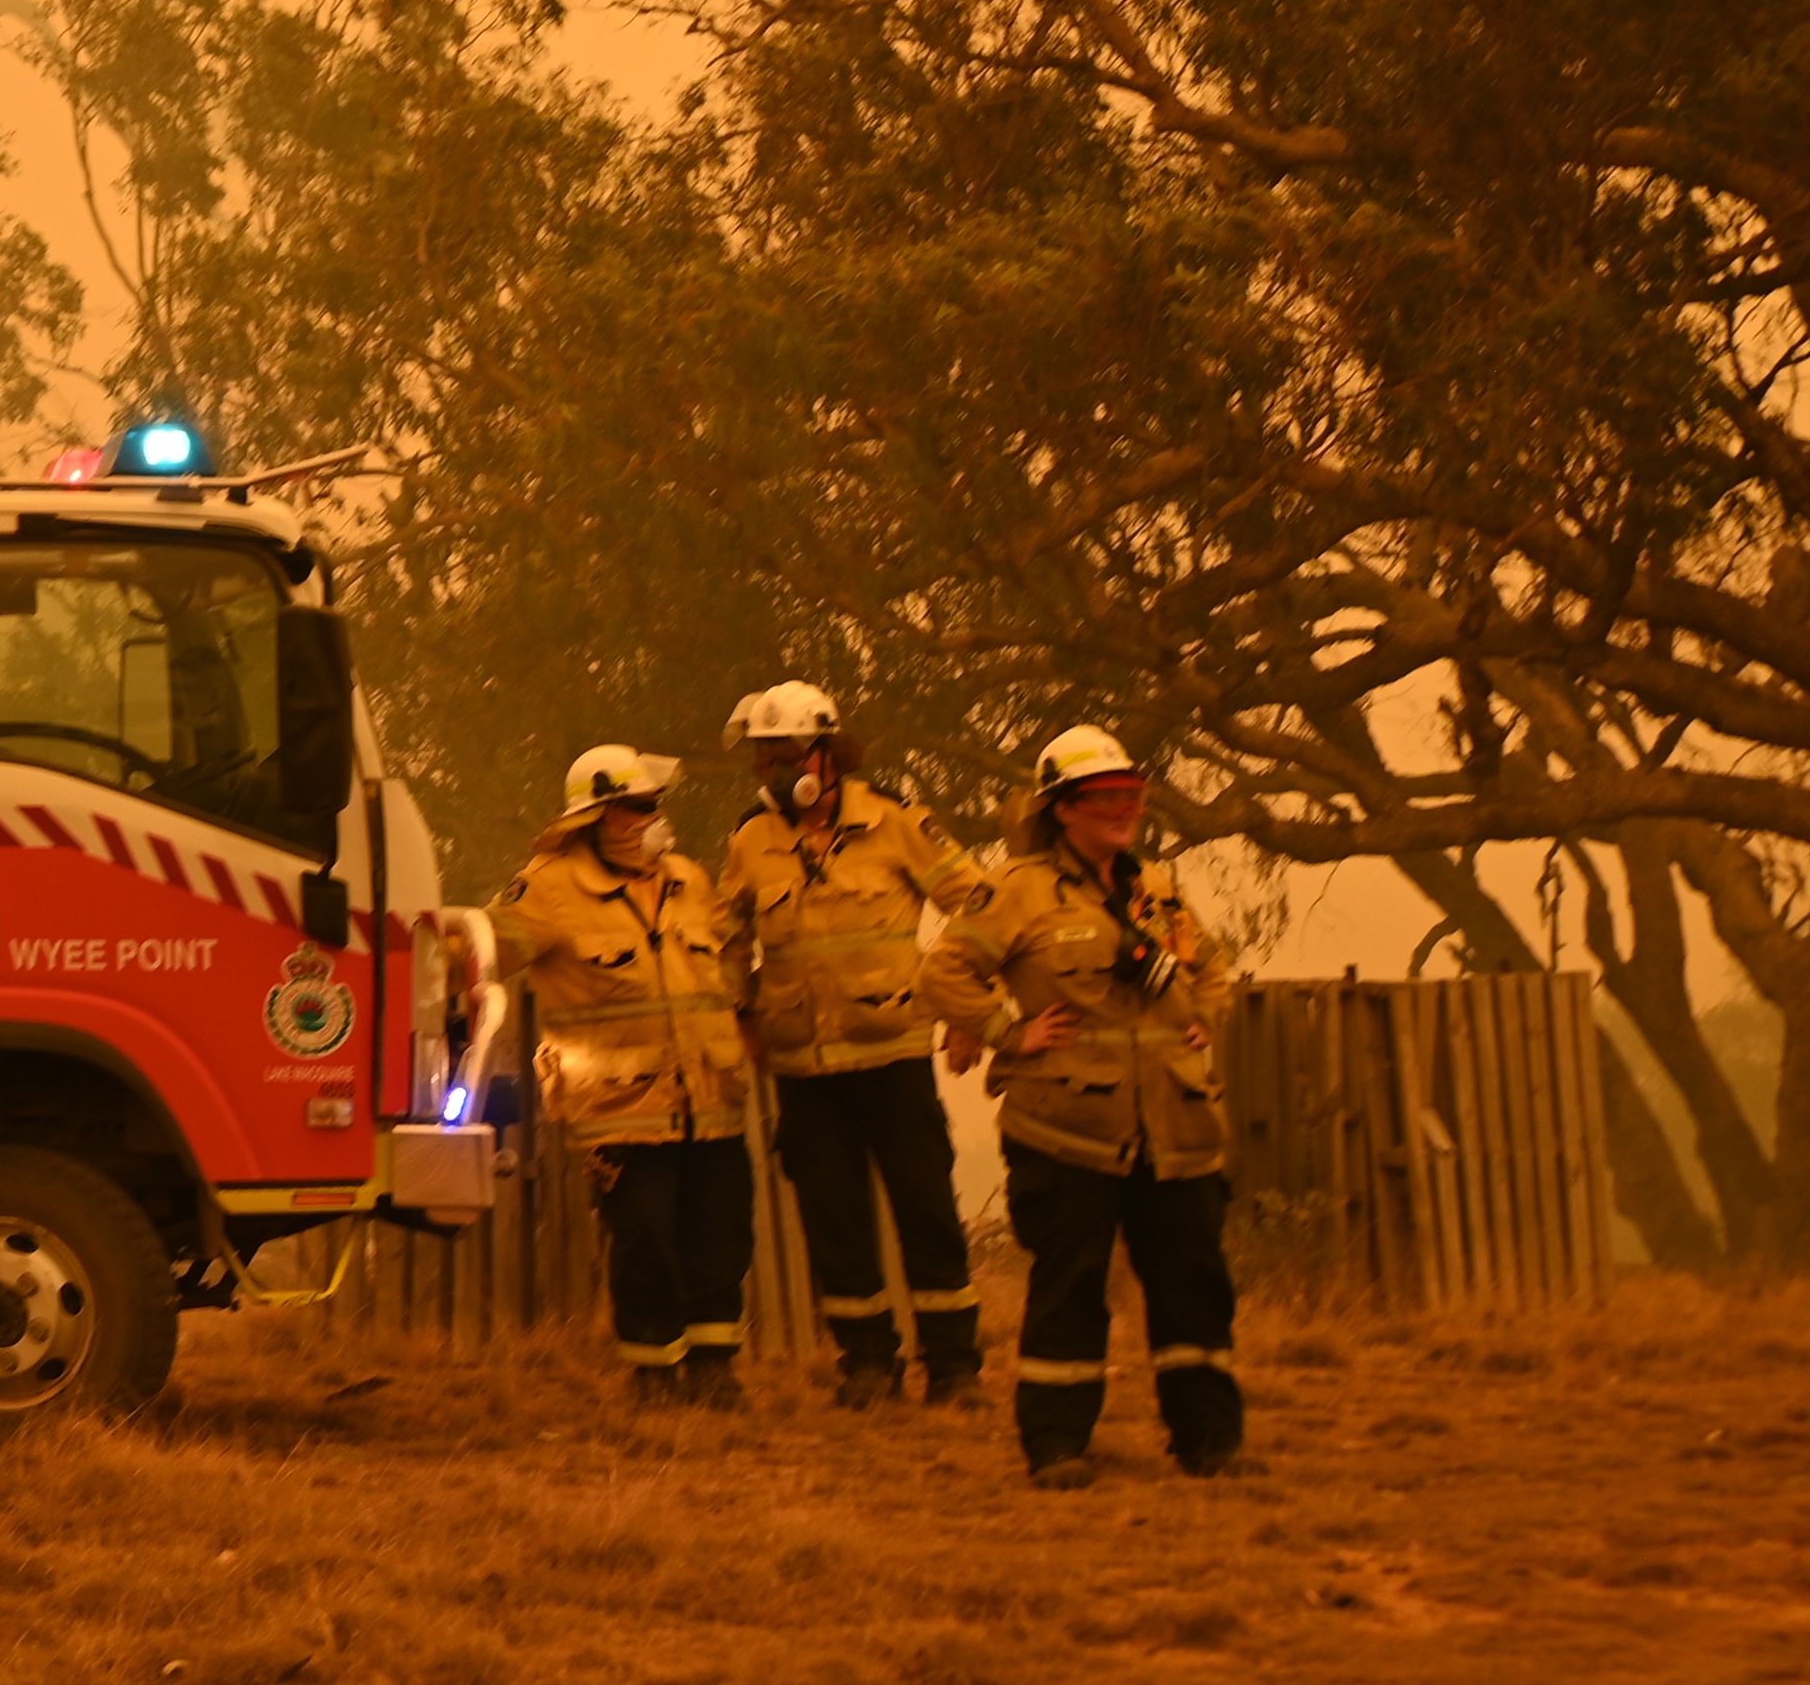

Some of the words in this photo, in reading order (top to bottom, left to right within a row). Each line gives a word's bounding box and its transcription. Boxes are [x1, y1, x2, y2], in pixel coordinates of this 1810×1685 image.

[8, 938, 107, 971] WYEE
[116, 938, 218, 972] POINT
[263, 1065, 292, 1082] LAKE
